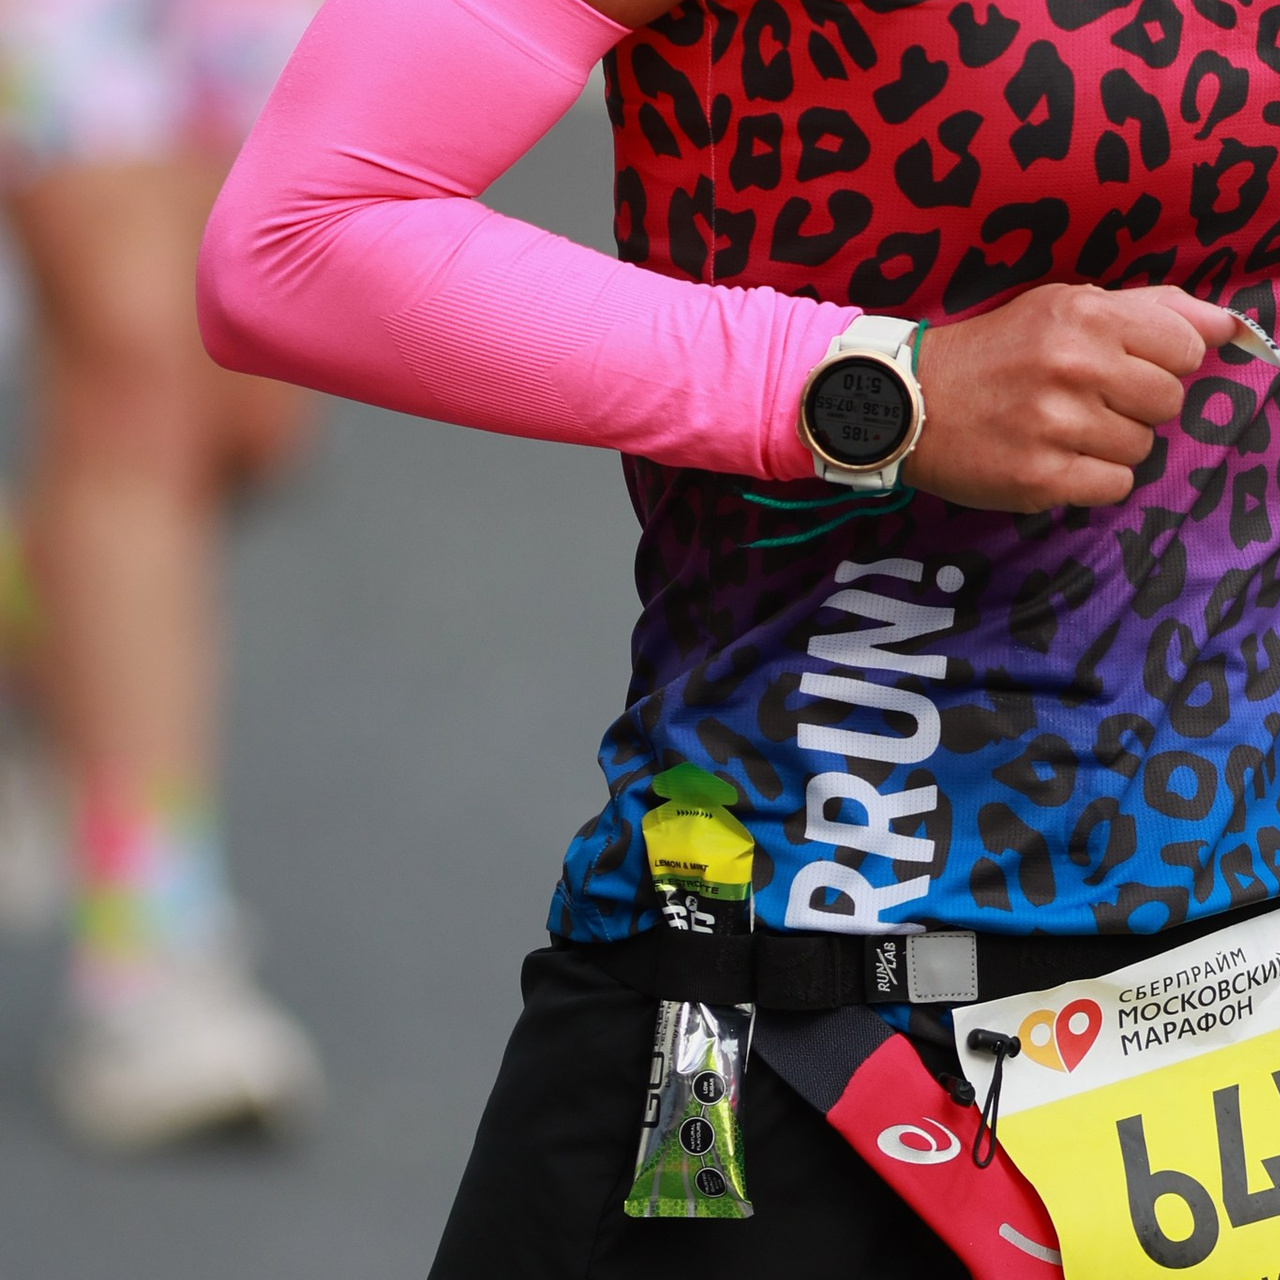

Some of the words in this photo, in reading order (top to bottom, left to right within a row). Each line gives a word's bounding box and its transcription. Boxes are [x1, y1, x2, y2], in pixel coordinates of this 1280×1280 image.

[842, 425, 870, 442] 185
[654, 859, 681, 869] LEMON
[1119, 948, 1247, 1003] СБЕРПРАЙМ
[1120, 996, 1253, 1056] МАРАФОН
